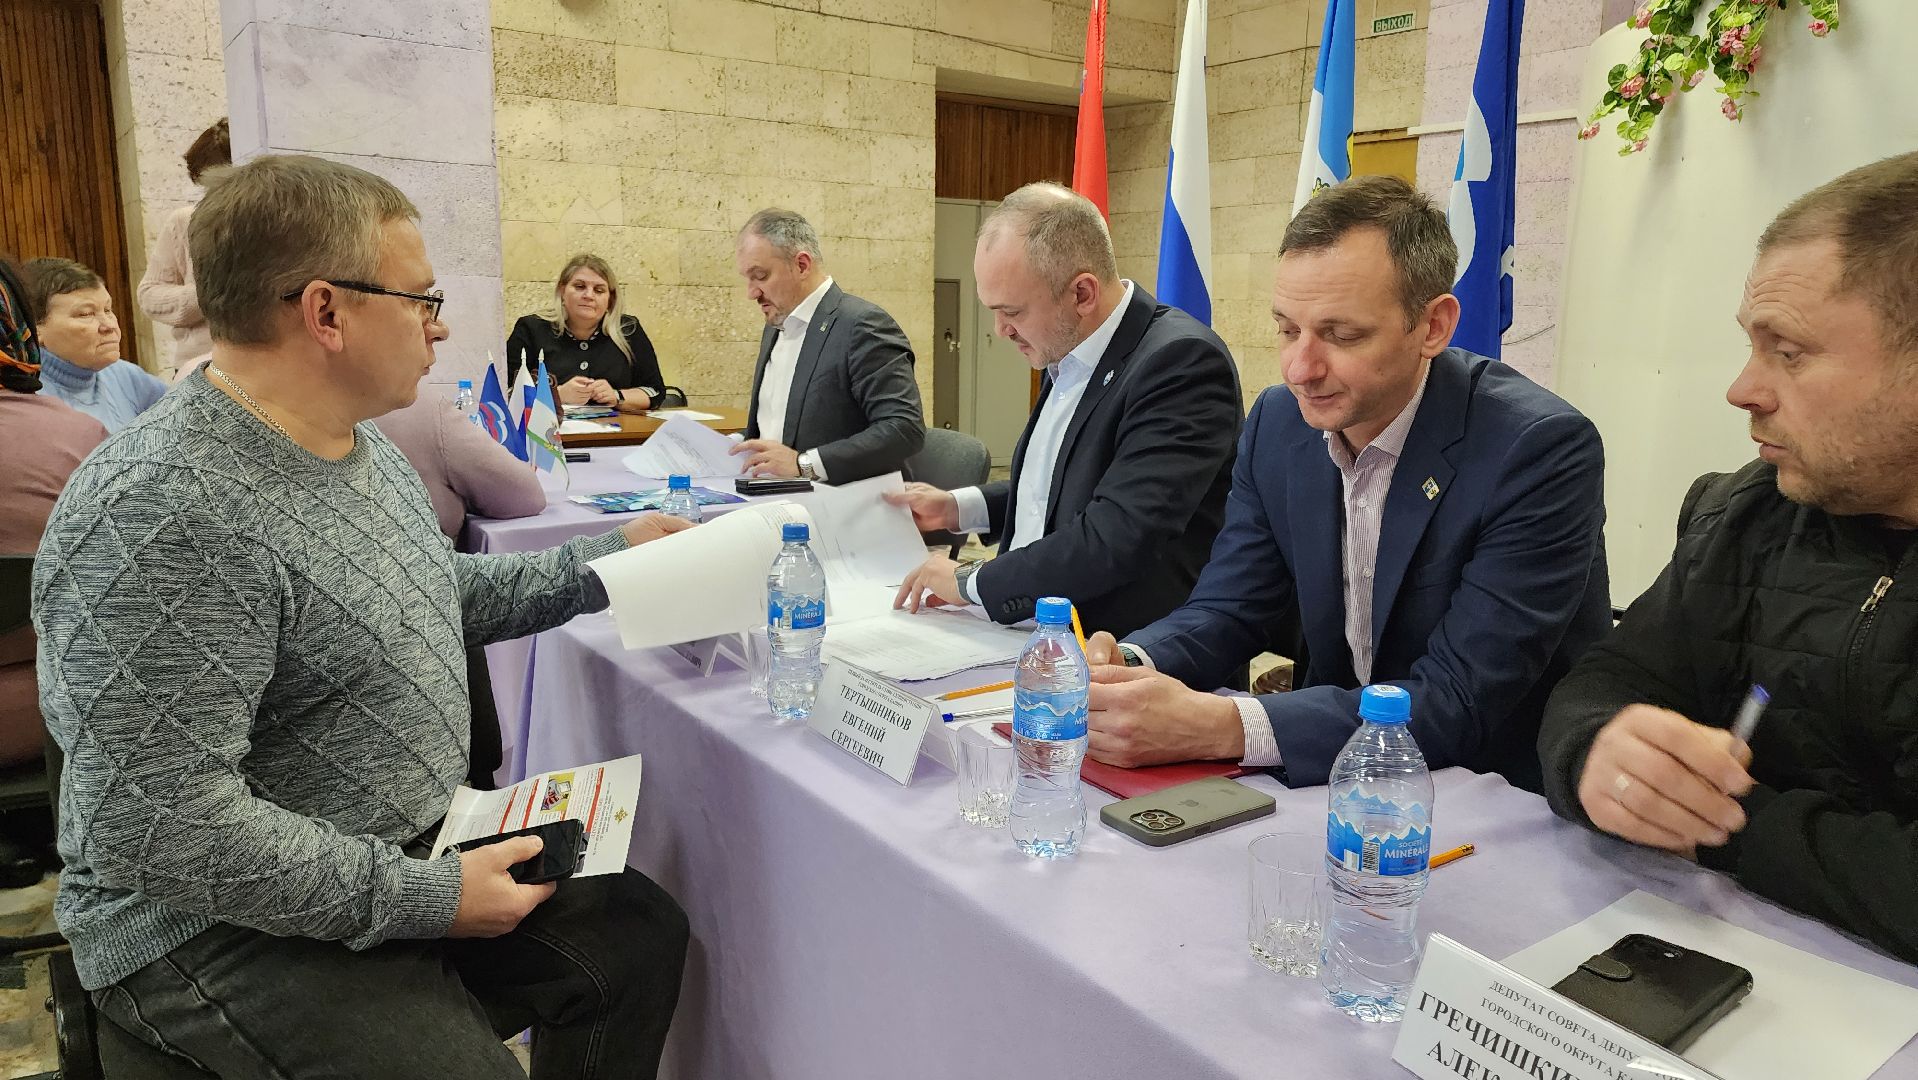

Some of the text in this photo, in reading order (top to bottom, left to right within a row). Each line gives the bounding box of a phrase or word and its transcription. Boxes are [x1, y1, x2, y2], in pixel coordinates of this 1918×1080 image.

[1375, 15, 1412, 32] ВЫХОД
[840, 684, 912, 731] ТЕРТЫШНИКОВ
[841, 710, 886, 743] ЕВГЕНИЙ
[831, 728, 885, 768] СЕРГЕЕВИЧ
[1488, 980, 1546, 1015] ДЕПУТАТ
[1547, 1010, 1596, 1043] СОВЕТА
[1480, 997, 1561, 1047] ГОРОДСКОГО
[1563, 1042, 1613, 1077] ОКРУГА
